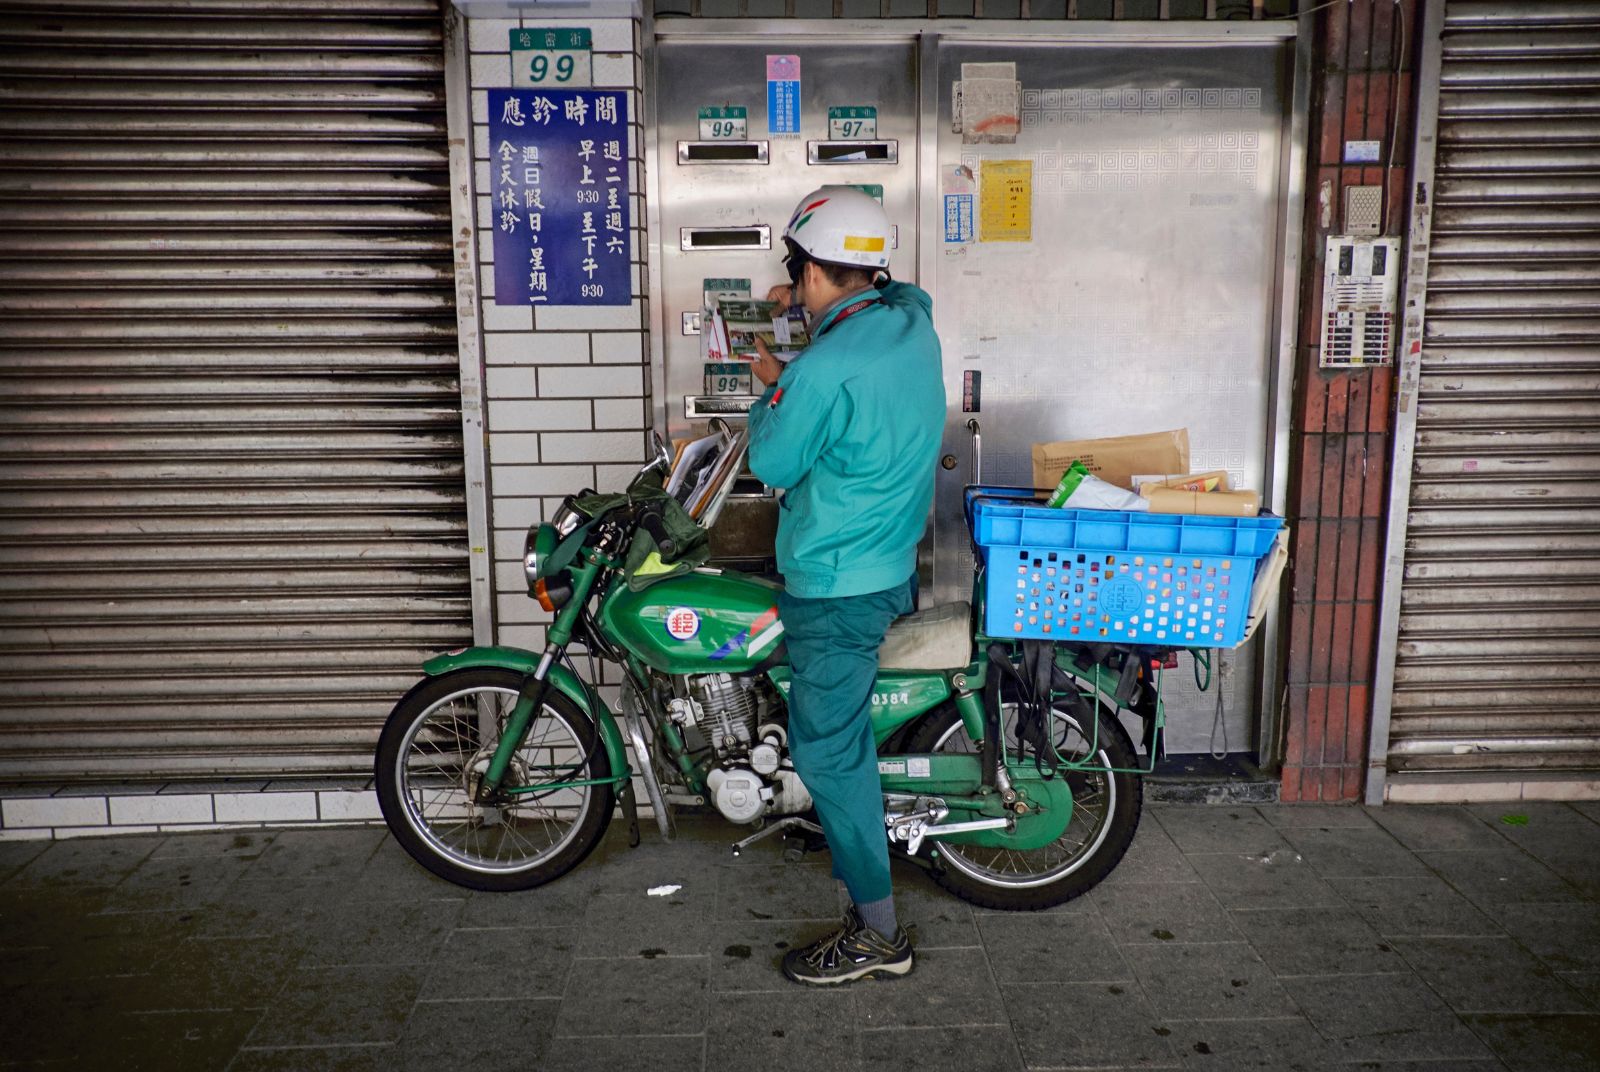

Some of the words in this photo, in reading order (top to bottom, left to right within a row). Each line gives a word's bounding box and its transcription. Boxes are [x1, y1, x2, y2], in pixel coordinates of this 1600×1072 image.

[519, 32, 582, 48] 哈密街
[529, 54, 575, 83] 99
[502, 95, 618, 127] 應診時間
[712, 121, 734, 138] 99
[842, 121, 863, 138] 97
[497, 140, 521, 235] 全天休診
[603, 140, 625, 255] 週二至週六
[718, 377, 738, 392] 99
[871, 692, 909, 705] 0384
